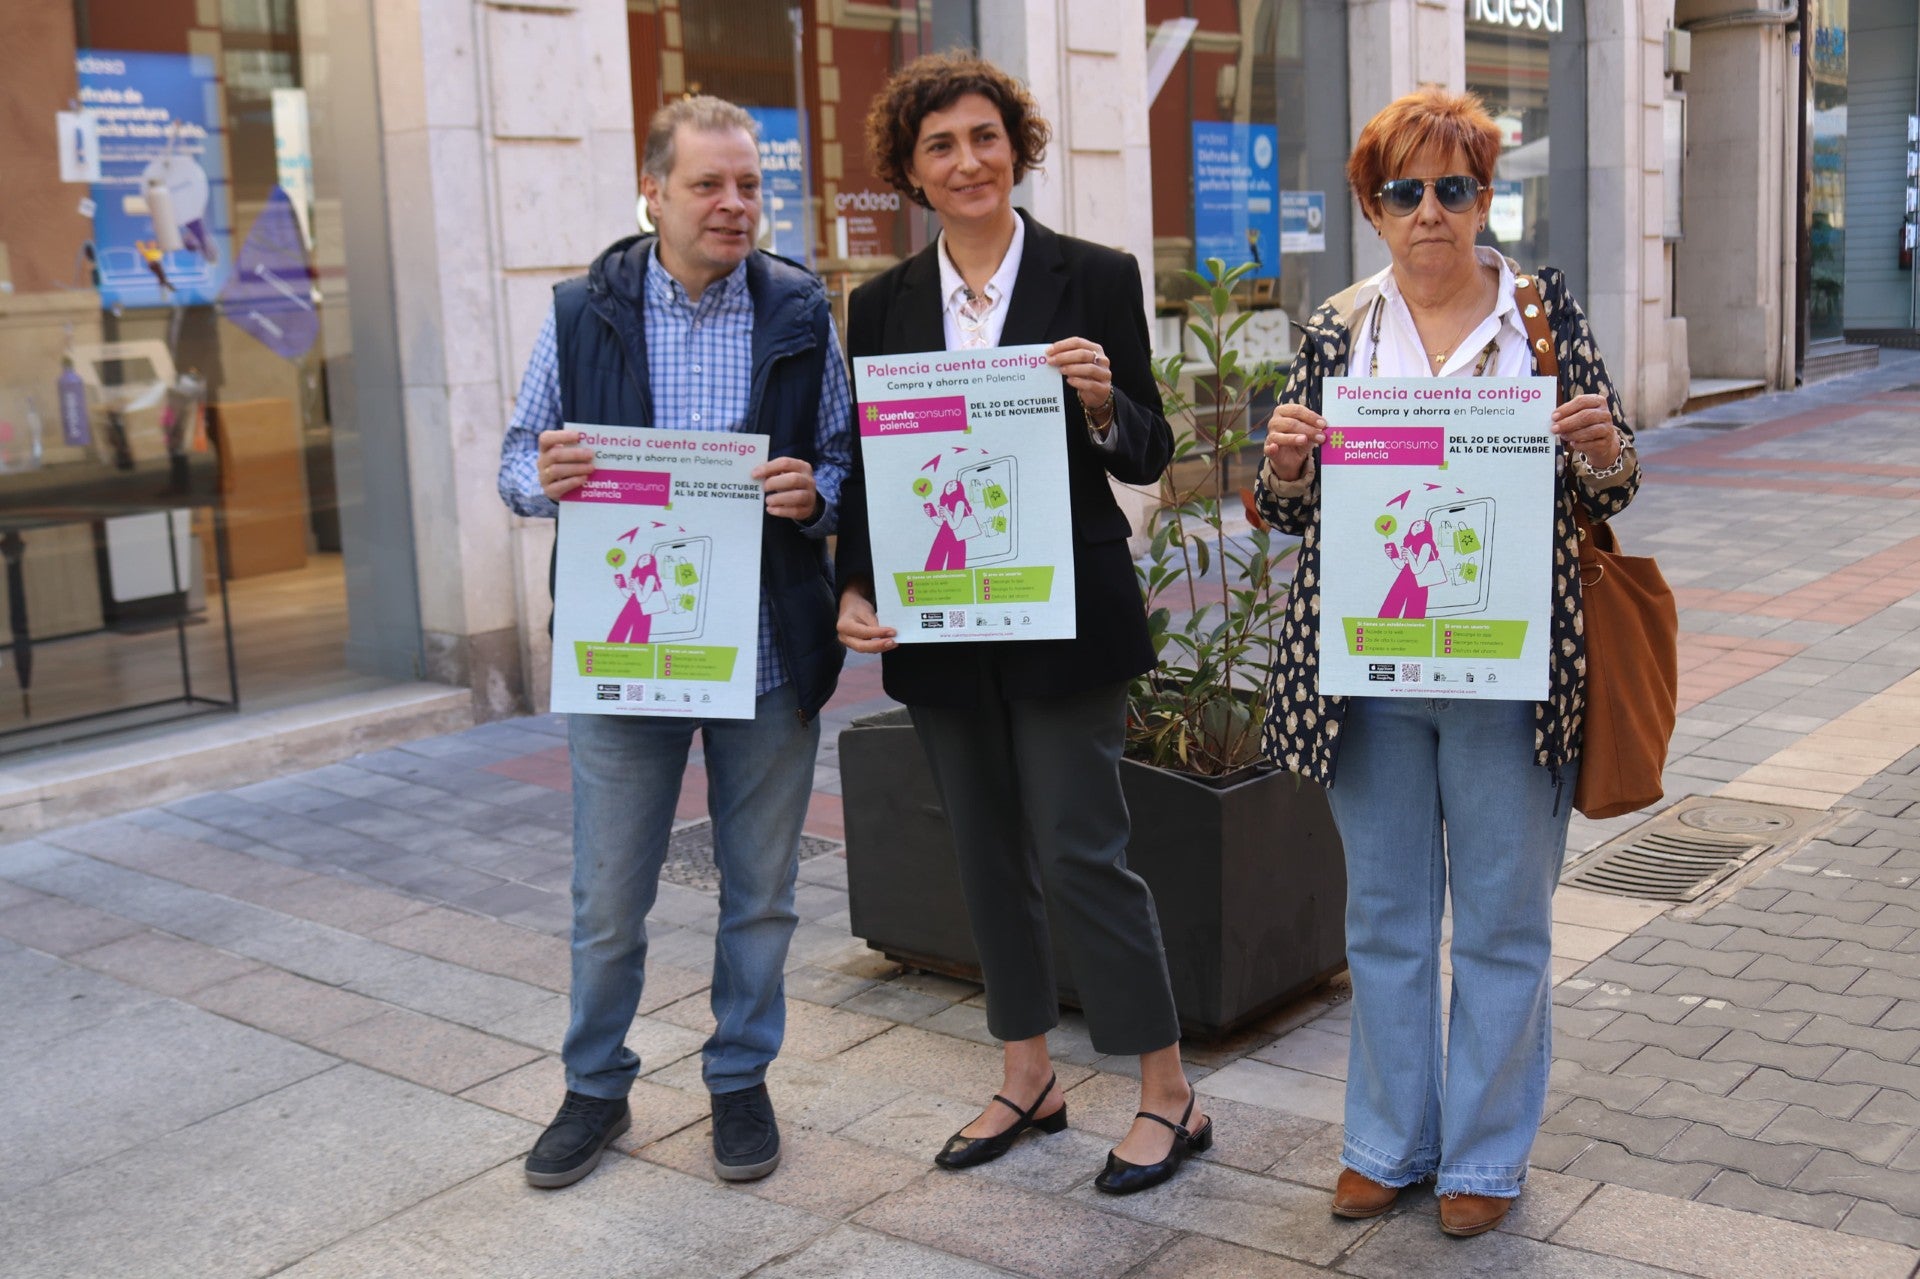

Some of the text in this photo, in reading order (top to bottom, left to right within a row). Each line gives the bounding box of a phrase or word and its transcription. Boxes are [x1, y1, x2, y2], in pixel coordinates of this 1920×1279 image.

[834, 189, 900, 211] endesa
[867, 354, 1047, 377] Palencia cuenta contigo
[887, 373, 1026, 392] Compra y ahorra en Palencia
[1337, 386, 1542, 402] Palencia cuenta contigo
[988, 401, 1001, 409] 20
[1017, 397, 1058, 406] OCTUBRE
[984, 410, 993, 418] 16
[995, 409, 1007, 417] DE
[1009, 406, 1061, 416] NOVIEMBRE
[1357, 406, 1515, 417] Compra y ahorra en Palencia
[879, 420, 919, 432] palencia
[577, 432, 756, 456] Palencia cuenta contigo
[1449, 446, 1550, 454] AL 16 DE NOVIEMBRE
[595, 450, 634, 462] Compra
[636, 454, 642, 463] y
[645, 453, 678, 464] ahorra
[694, 455, 734, 466] Palencia
[1344, 449, 1389, 461] palencia
[675, 480, 760, 492] DEL 20 DE OCTUBRE
[581, 490, 622, 500] palencia
[674, 489, 686, 497] AL
[711, 491, 761, 500] NOVIEMBRE
